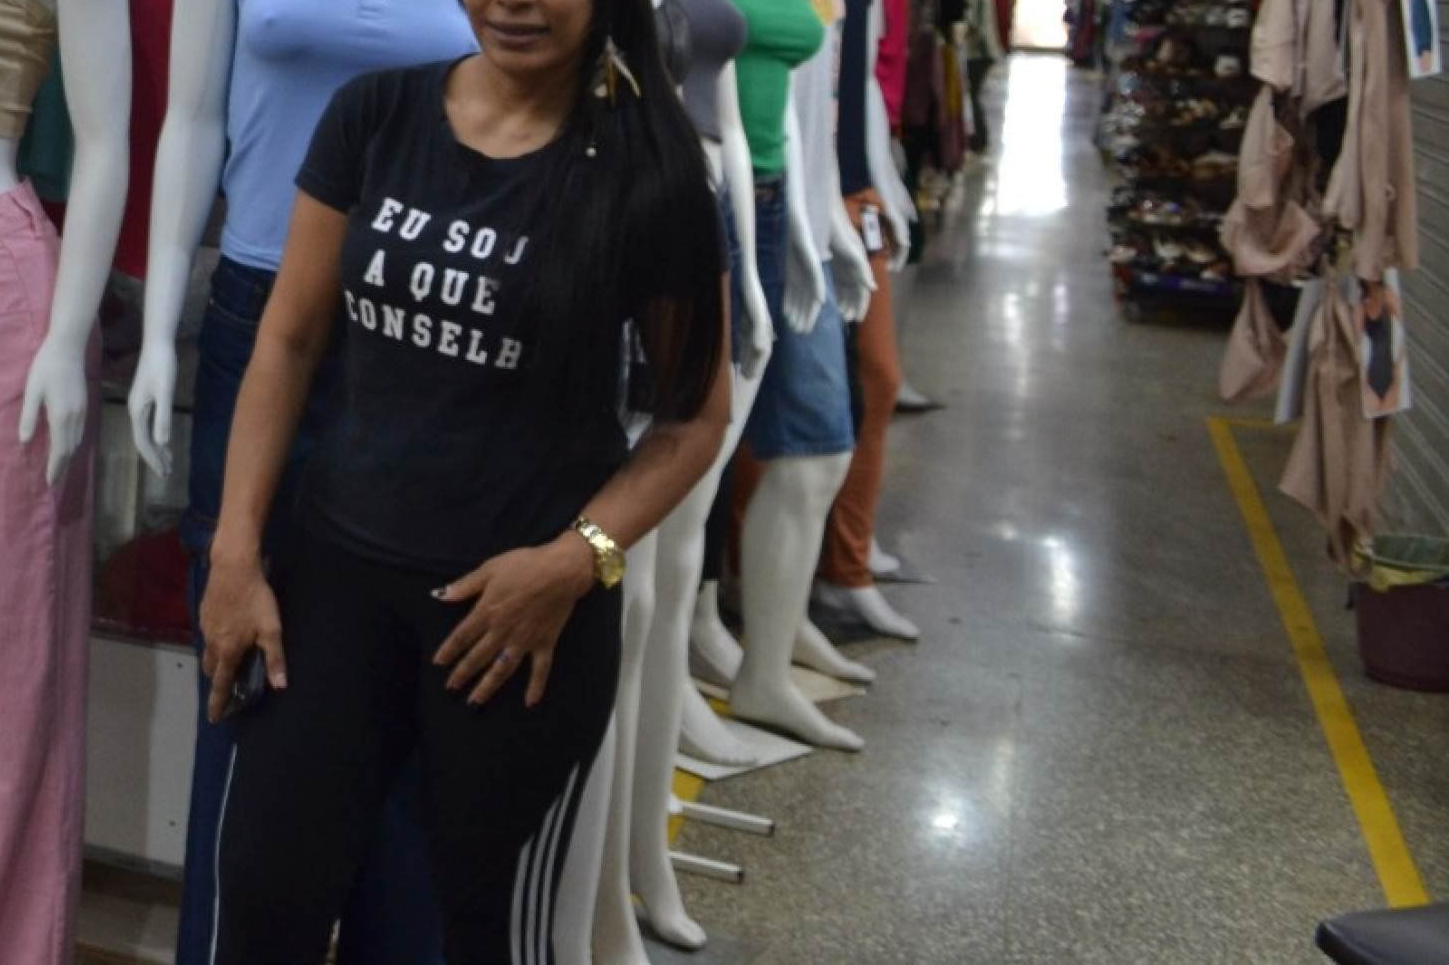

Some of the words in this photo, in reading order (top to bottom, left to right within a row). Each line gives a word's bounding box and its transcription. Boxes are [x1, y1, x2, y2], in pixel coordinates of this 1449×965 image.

[371, 197, 431, 241] EU
[363, 249, 386, 287] A
[409, 261, 500, 315] QUE
